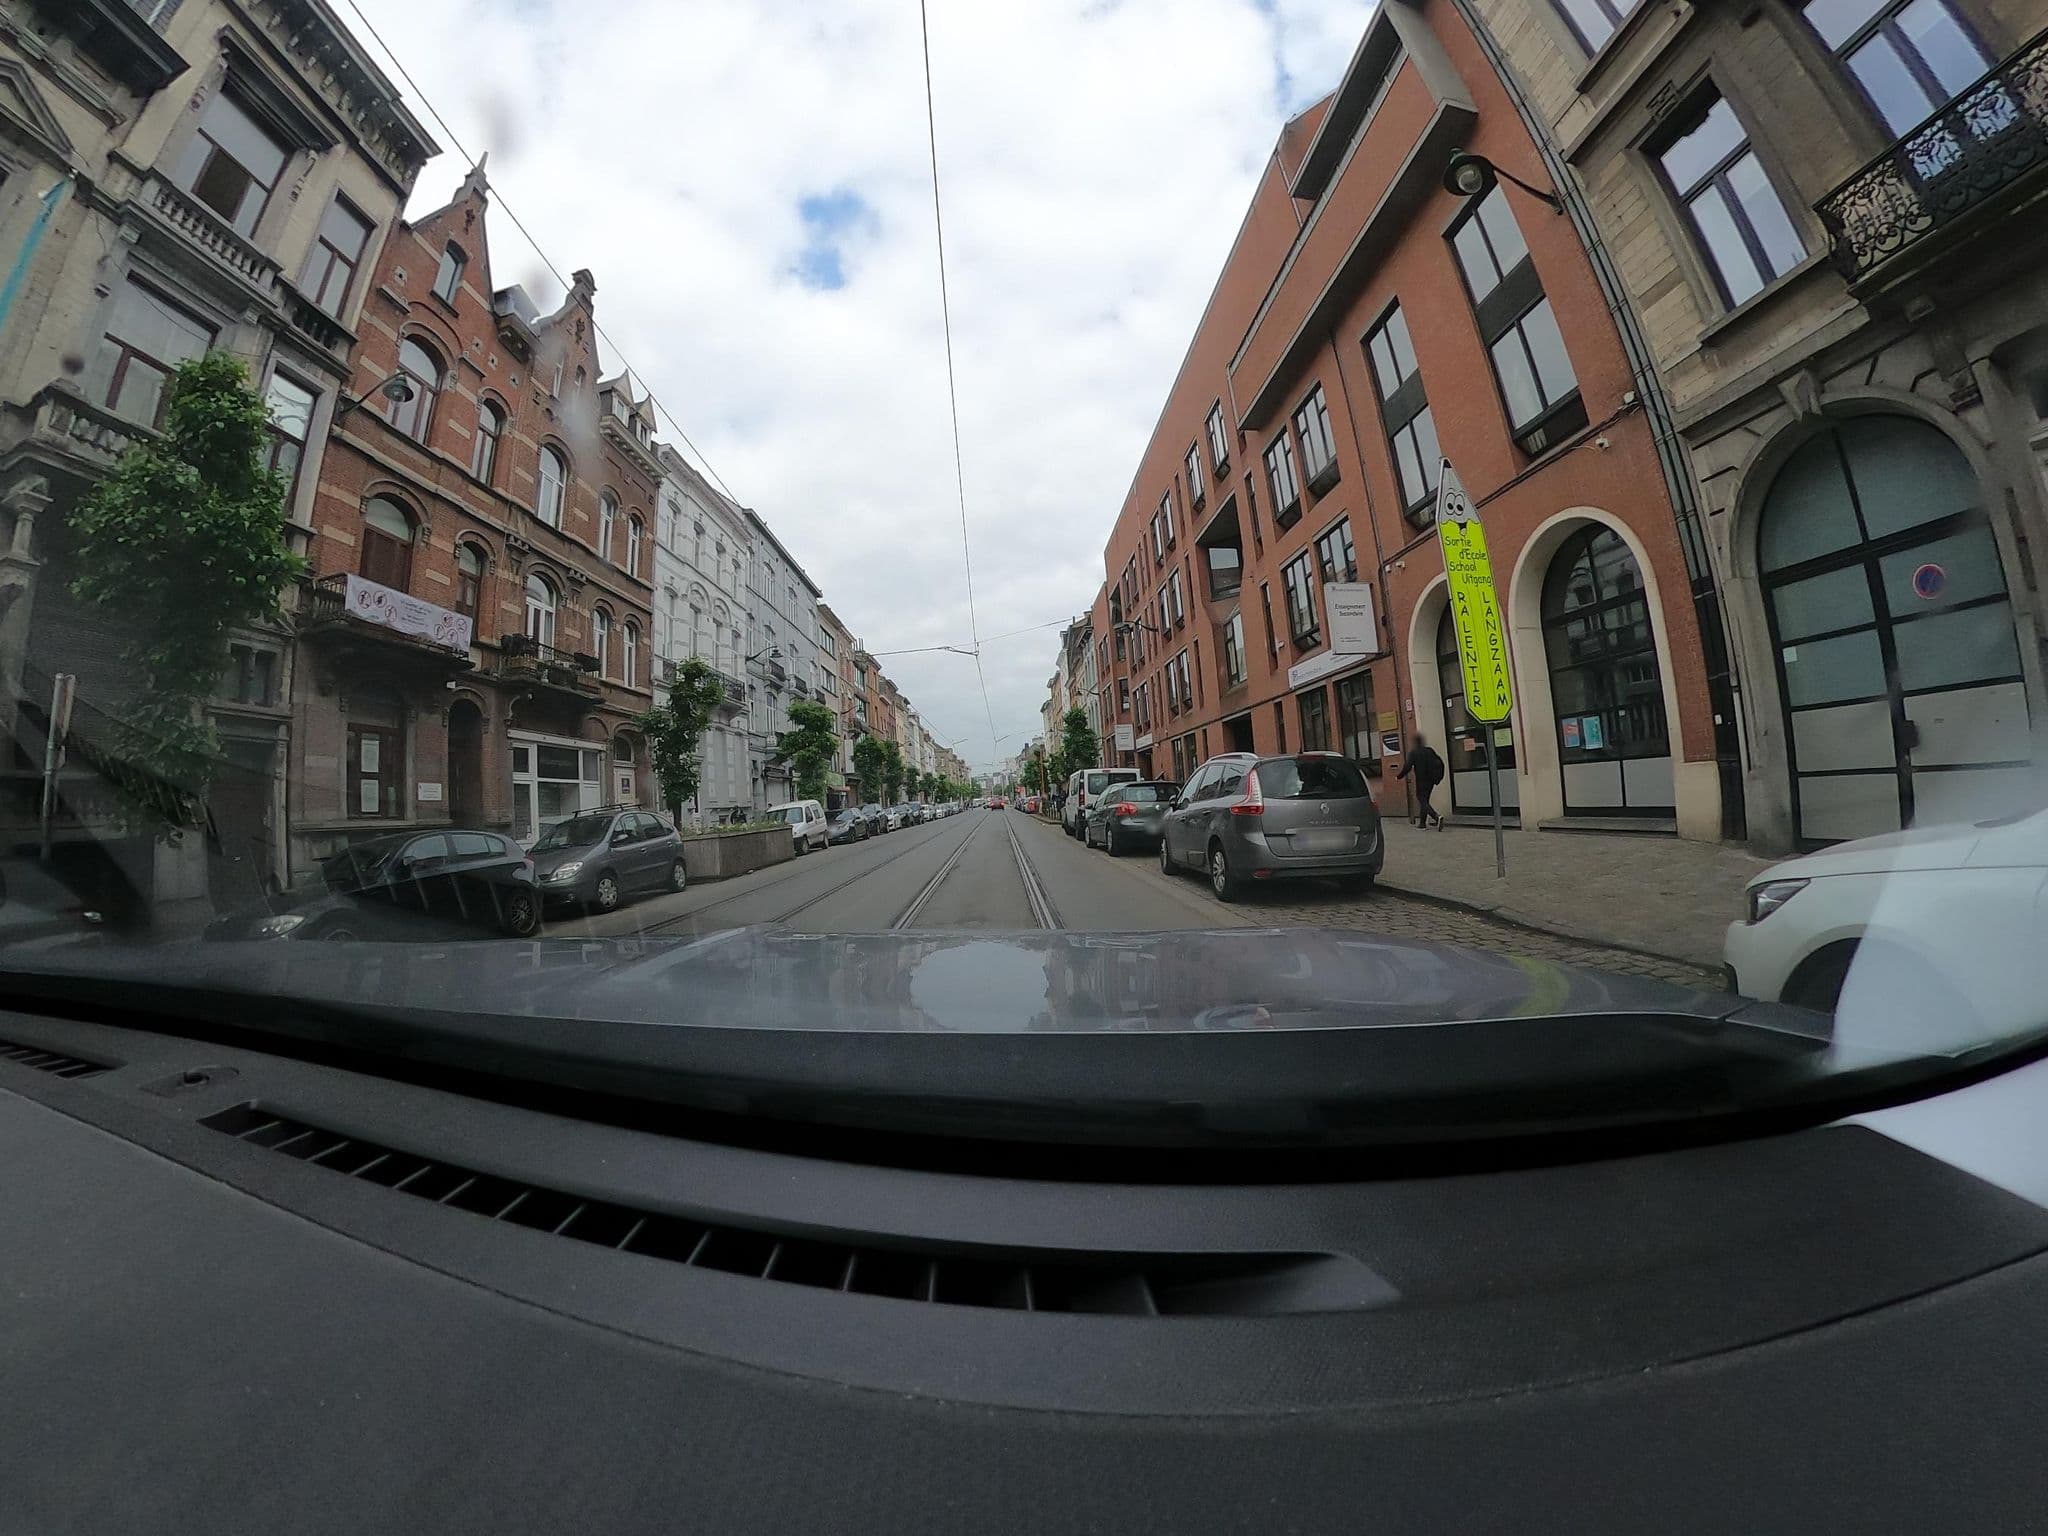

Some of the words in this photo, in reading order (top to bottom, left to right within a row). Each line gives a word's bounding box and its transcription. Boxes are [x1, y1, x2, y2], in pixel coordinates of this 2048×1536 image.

[1445, 536, 1472, 547] Sortie
[1449, 561, 1477, 572] School
[1462, 573, 1492, 587] Uitgang
[1457, 592, 1481, 707] RALENTIR
[1482, 592, 1508, 706] LANGZAAM
